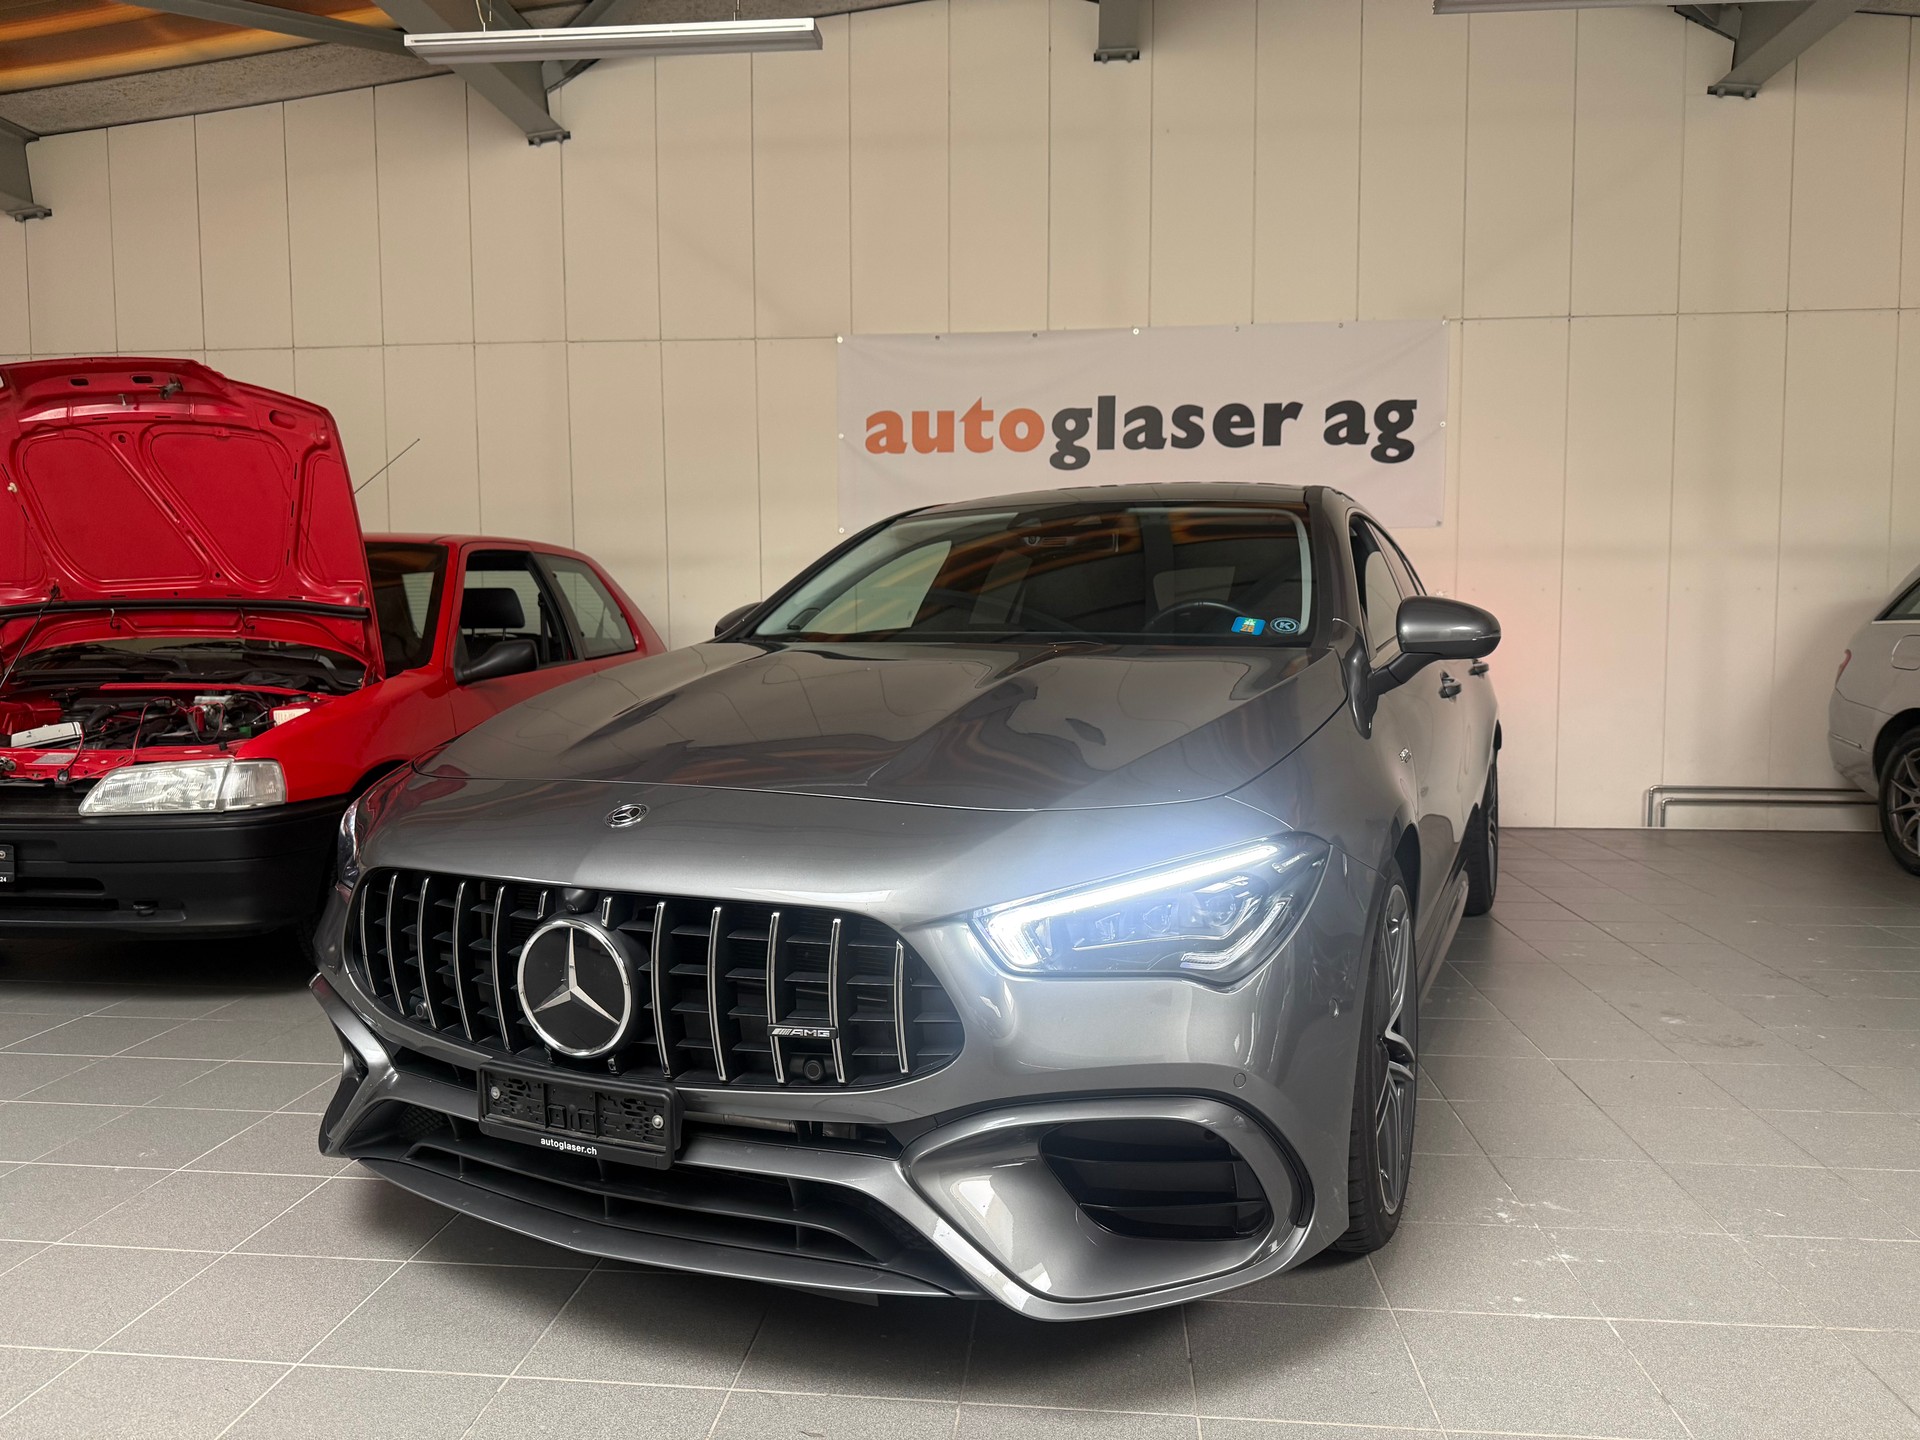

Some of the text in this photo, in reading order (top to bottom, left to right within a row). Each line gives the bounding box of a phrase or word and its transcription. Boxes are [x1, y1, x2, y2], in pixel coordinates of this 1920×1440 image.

[865, 395, 1418, 471] autoglaser ag
[789, 1028, 830, 1038] AMG
[540, 1137, 598, 1156] autoglaser.ch
